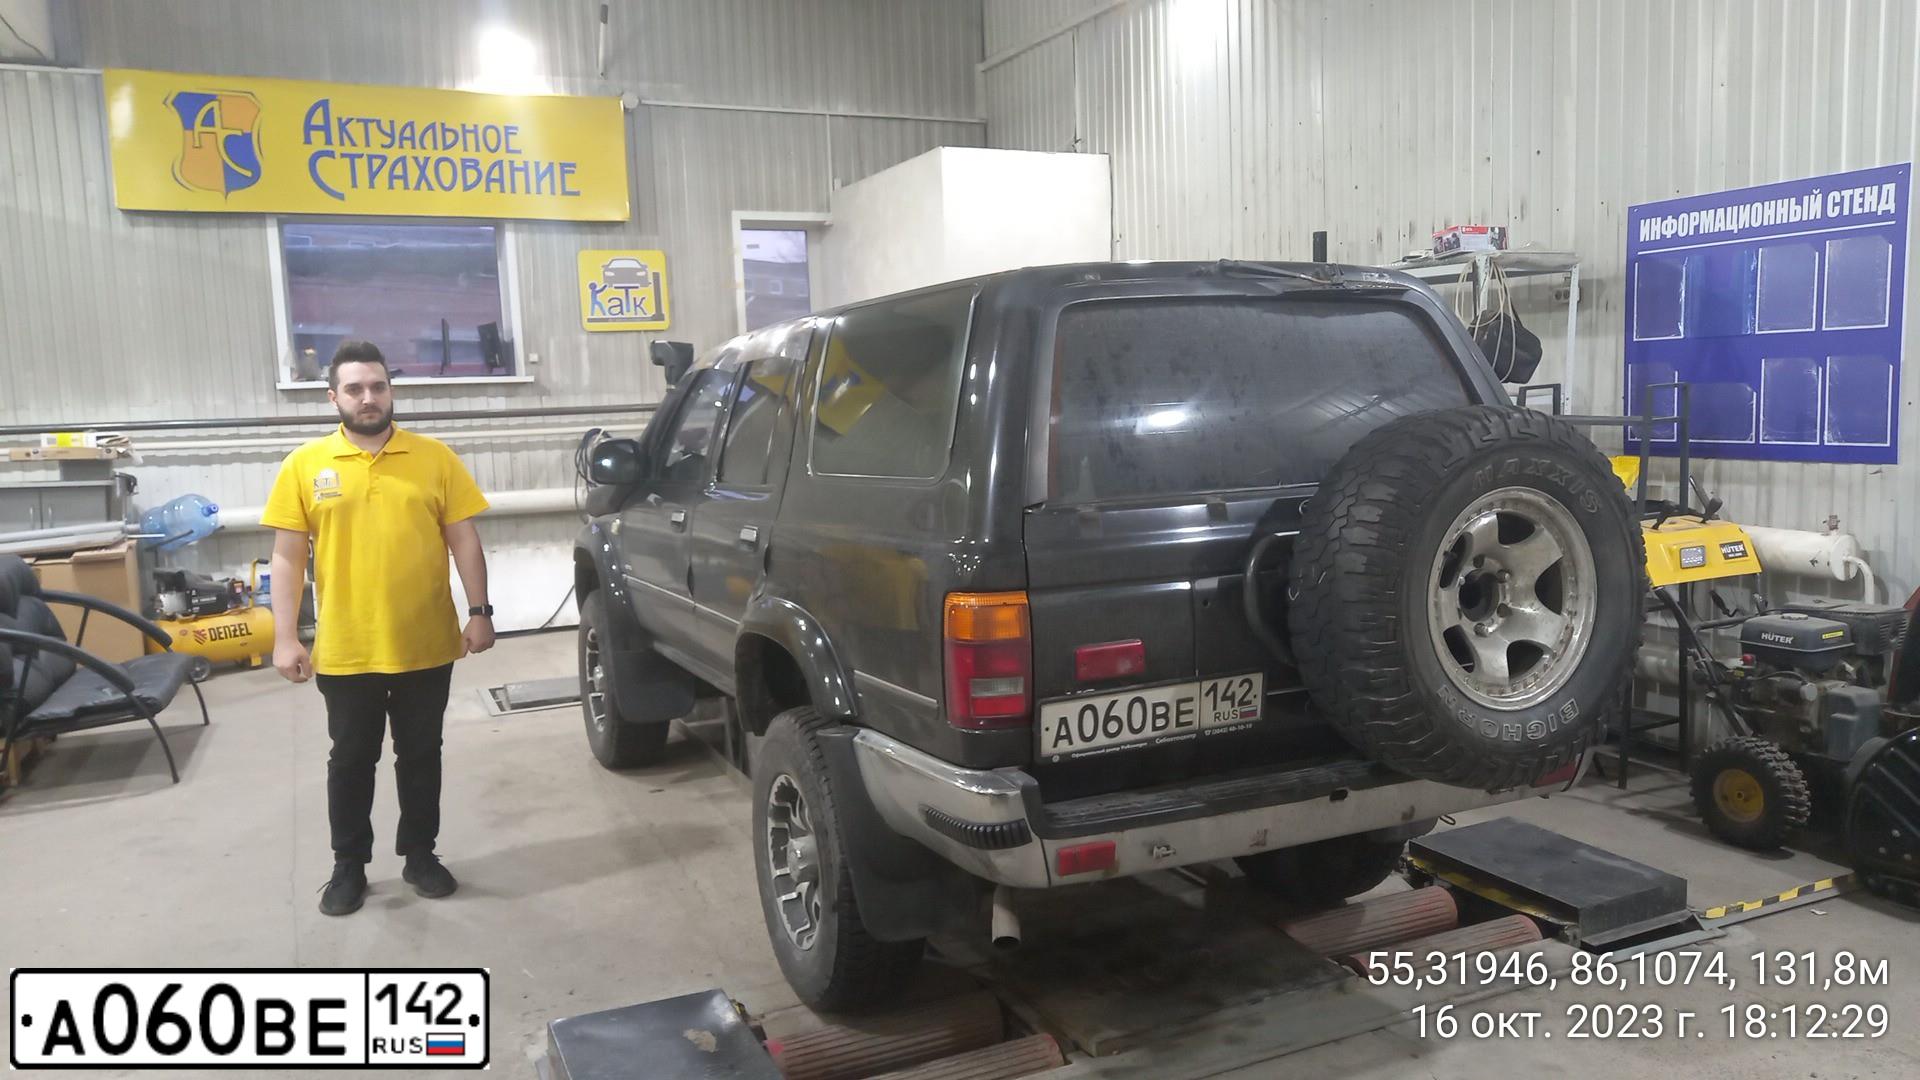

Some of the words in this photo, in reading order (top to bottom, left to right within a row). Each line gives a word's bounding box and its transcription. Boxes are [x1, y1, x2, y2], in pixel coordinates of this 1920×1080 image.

[303, 98, 522, 154] АКТУАЛЬНОЕ
[308, 150, 581, 202] СТРАХОВАНИЕ
[1639, 188, 1823, 243] ИНФОРМАЦИОННЫЙ
[1826, 182, 1897, 218] СТЕНД
[208, 622, 253, 642] DENZEL
[1761, 632, 1794, 644] HÜTER
[1053, 695, 1194, 749] А060ВЕ
[1204, 677, 1254, 711] 142
[1214, 709, 1239, 723] RUS
